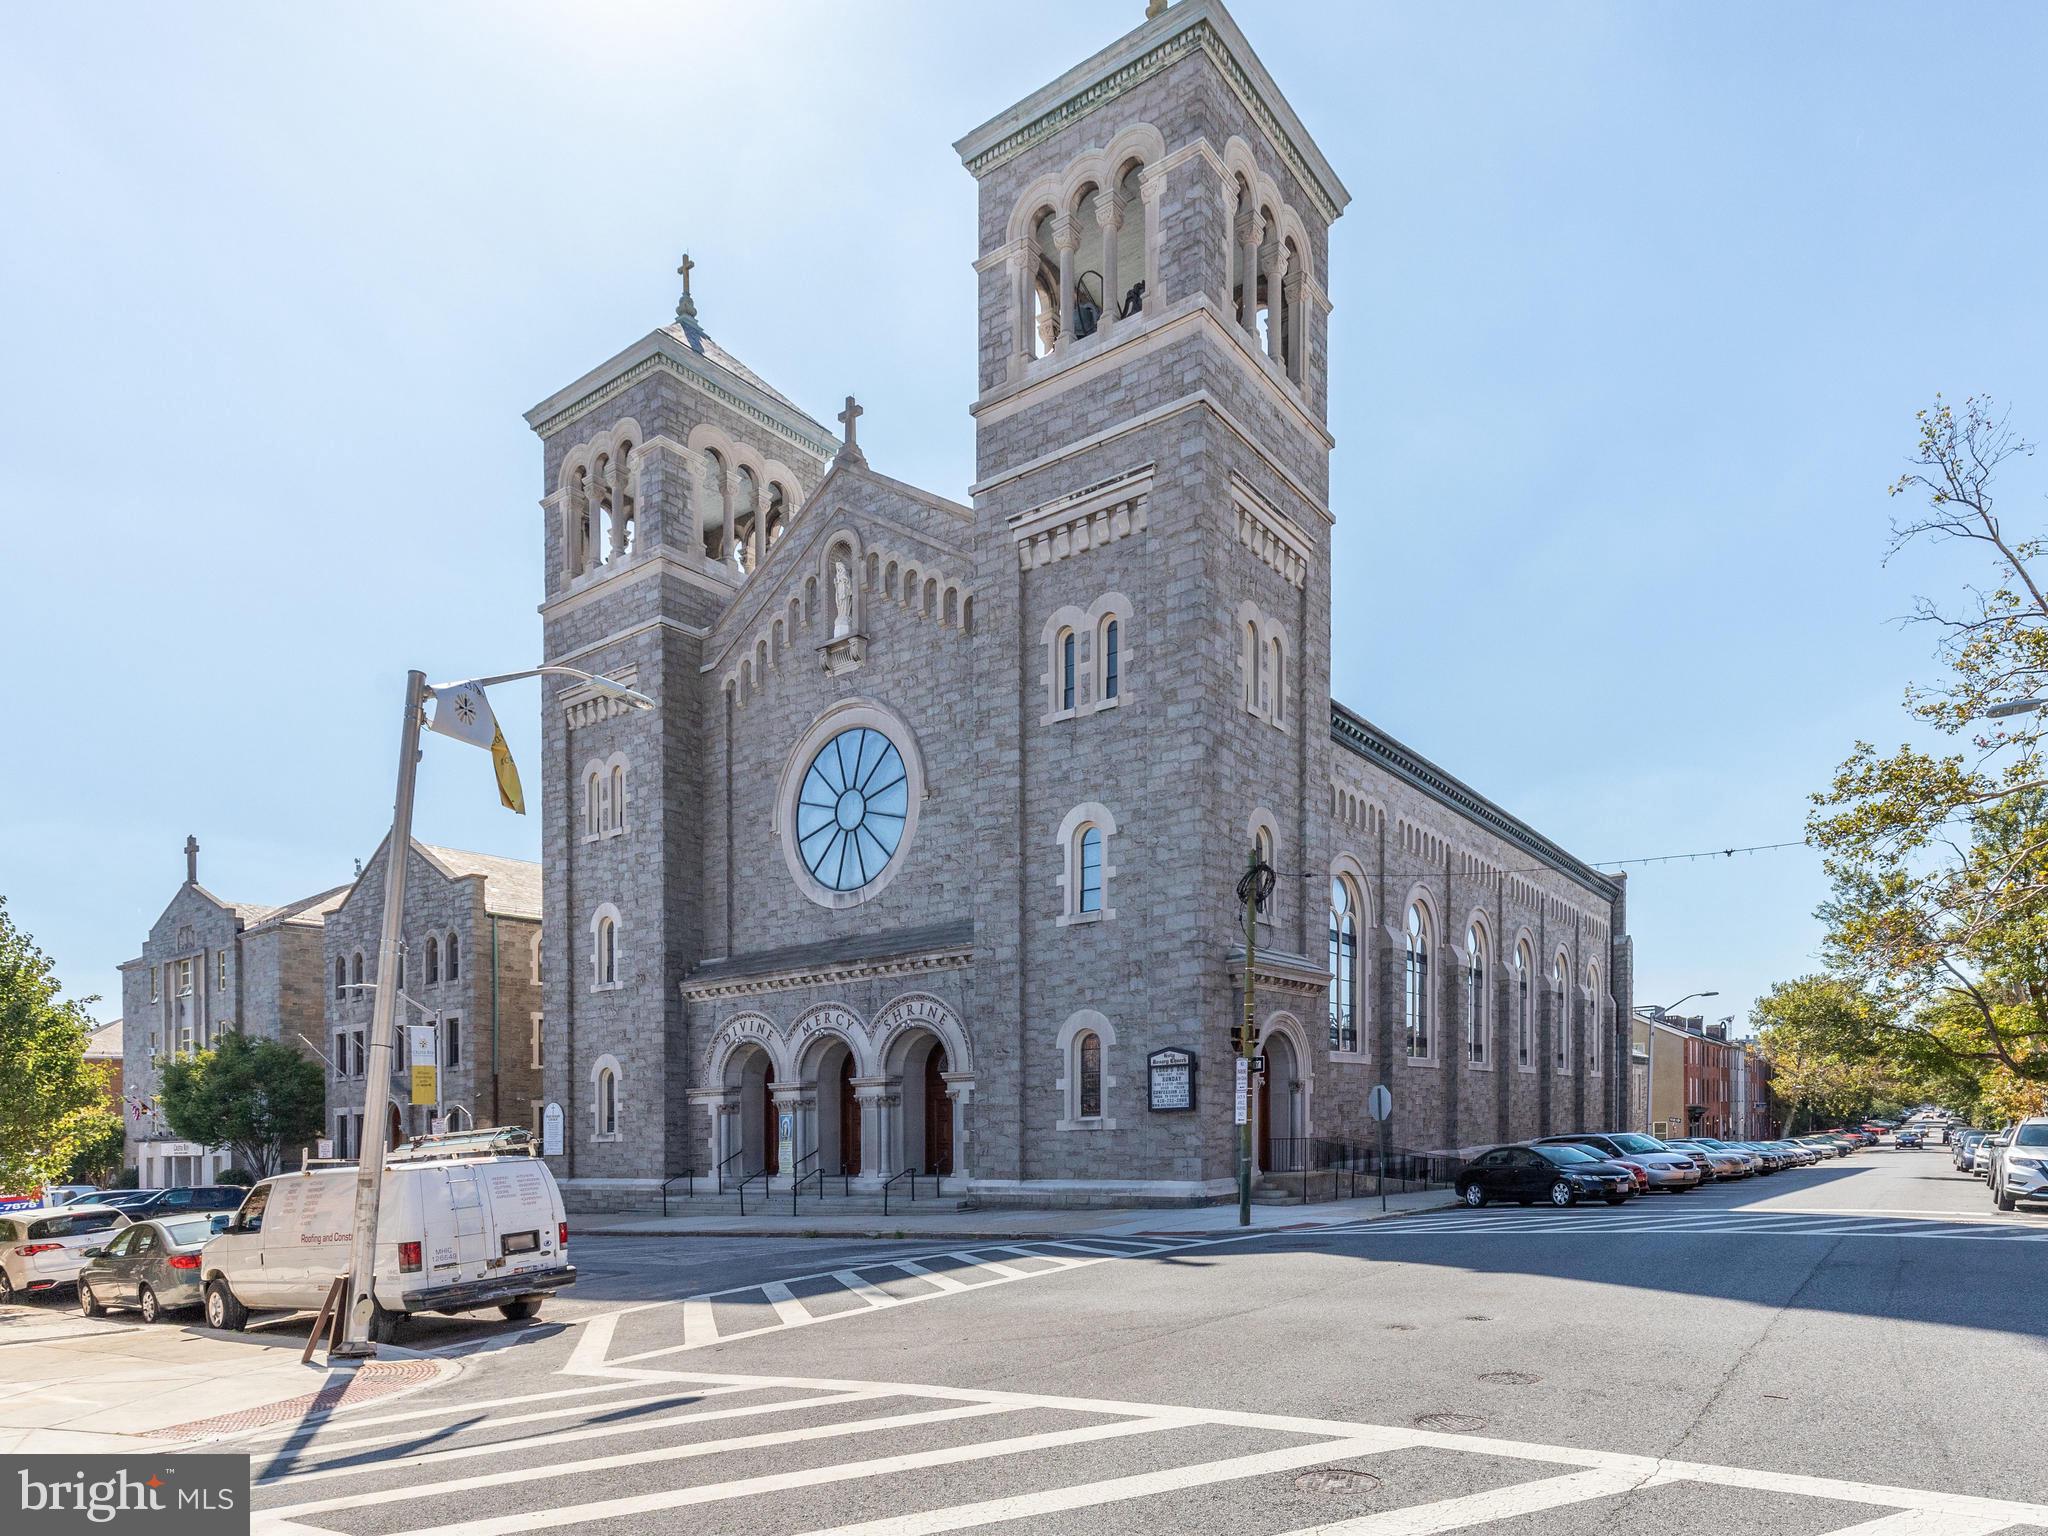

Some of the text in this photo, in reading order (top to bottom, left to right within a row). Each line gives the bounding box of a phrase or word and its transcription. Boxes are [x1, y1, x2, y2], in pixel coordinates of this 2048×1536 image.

[722, 1002, 948, 1045] DIVINE MERCY SHRINE
[300, 1234, 321, 1244] Roofing
[322, 1234, 333, 1242] and
